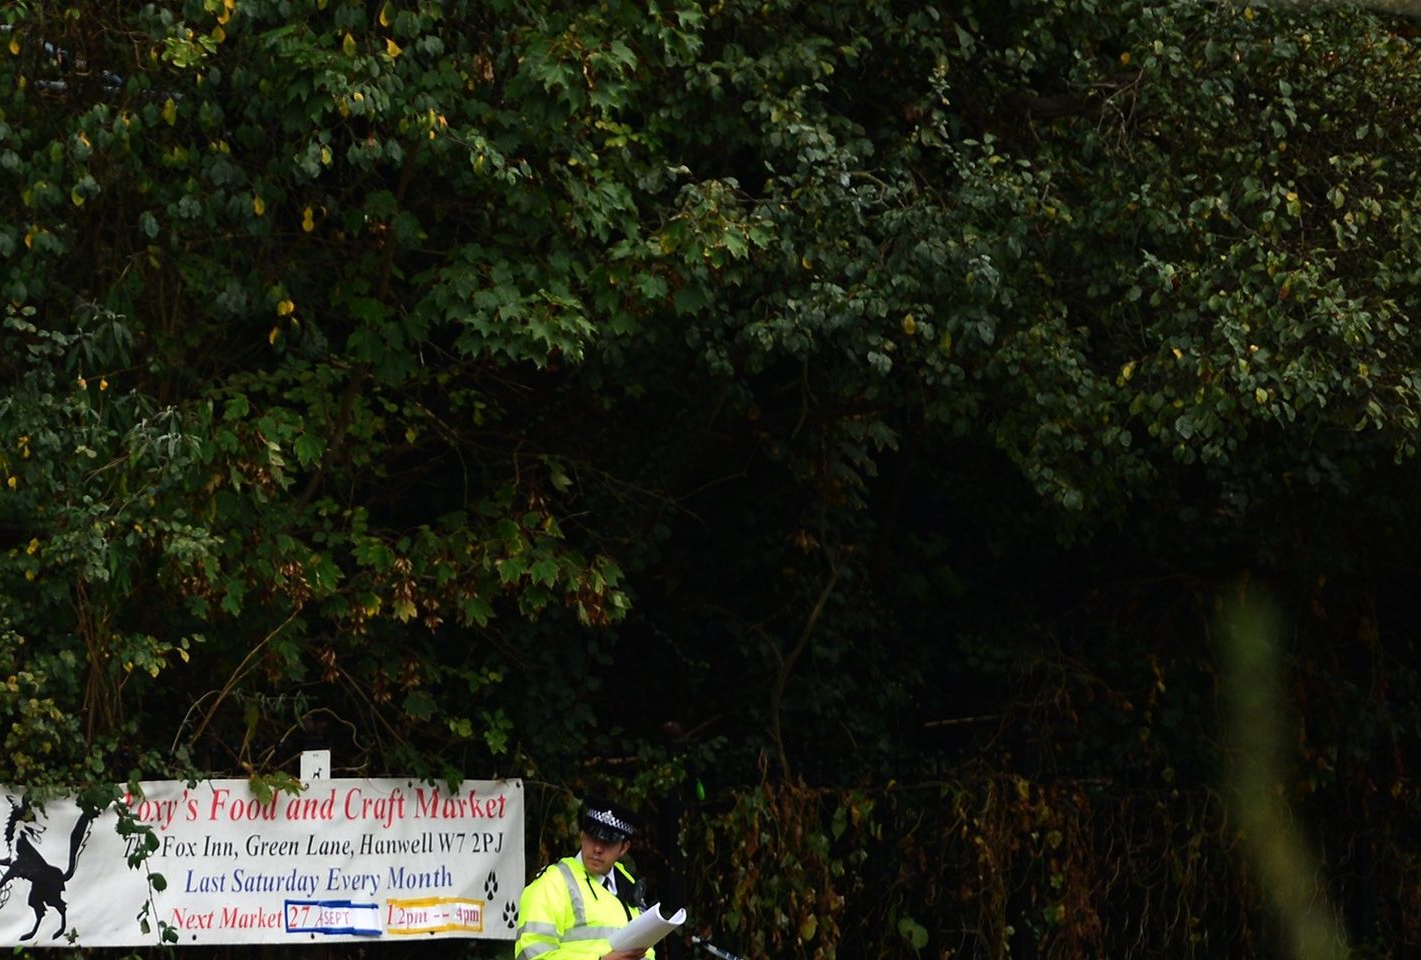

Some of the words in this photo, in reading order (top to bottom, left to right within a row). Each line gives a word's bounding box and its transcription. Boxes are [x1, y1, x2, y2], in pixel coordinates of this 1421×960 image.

[125, 789, 198, 831] oxy's
[209, 788, 278, 822] Food
[285, 788, 336, 821] and
[344, 787, 405, 829] Craft
[414, 787, 507, 819] Market
[162, 835, 197, 857] Fox
[202, 835, 239, 860] Inn,
[246, 833, 299, 857] Green
[306, 834, 354, 860] Lane,
[359, 832, 433, 855] Hanwell
[437, 832, 466, 853] W7
[472, 832, 504, 854] 2PJ
[184, 869, 226, 893] Last
[231, 867, 320, 898] Saturday
[325, 867, 381, 896] Every
[387, 865, 453, 890] Month
[171, 906, 214, 930] Next
[218, 905, 283, 929] Market
[288, 905, 311, 928] 27
[456, 906, 479, 926] 4pm
